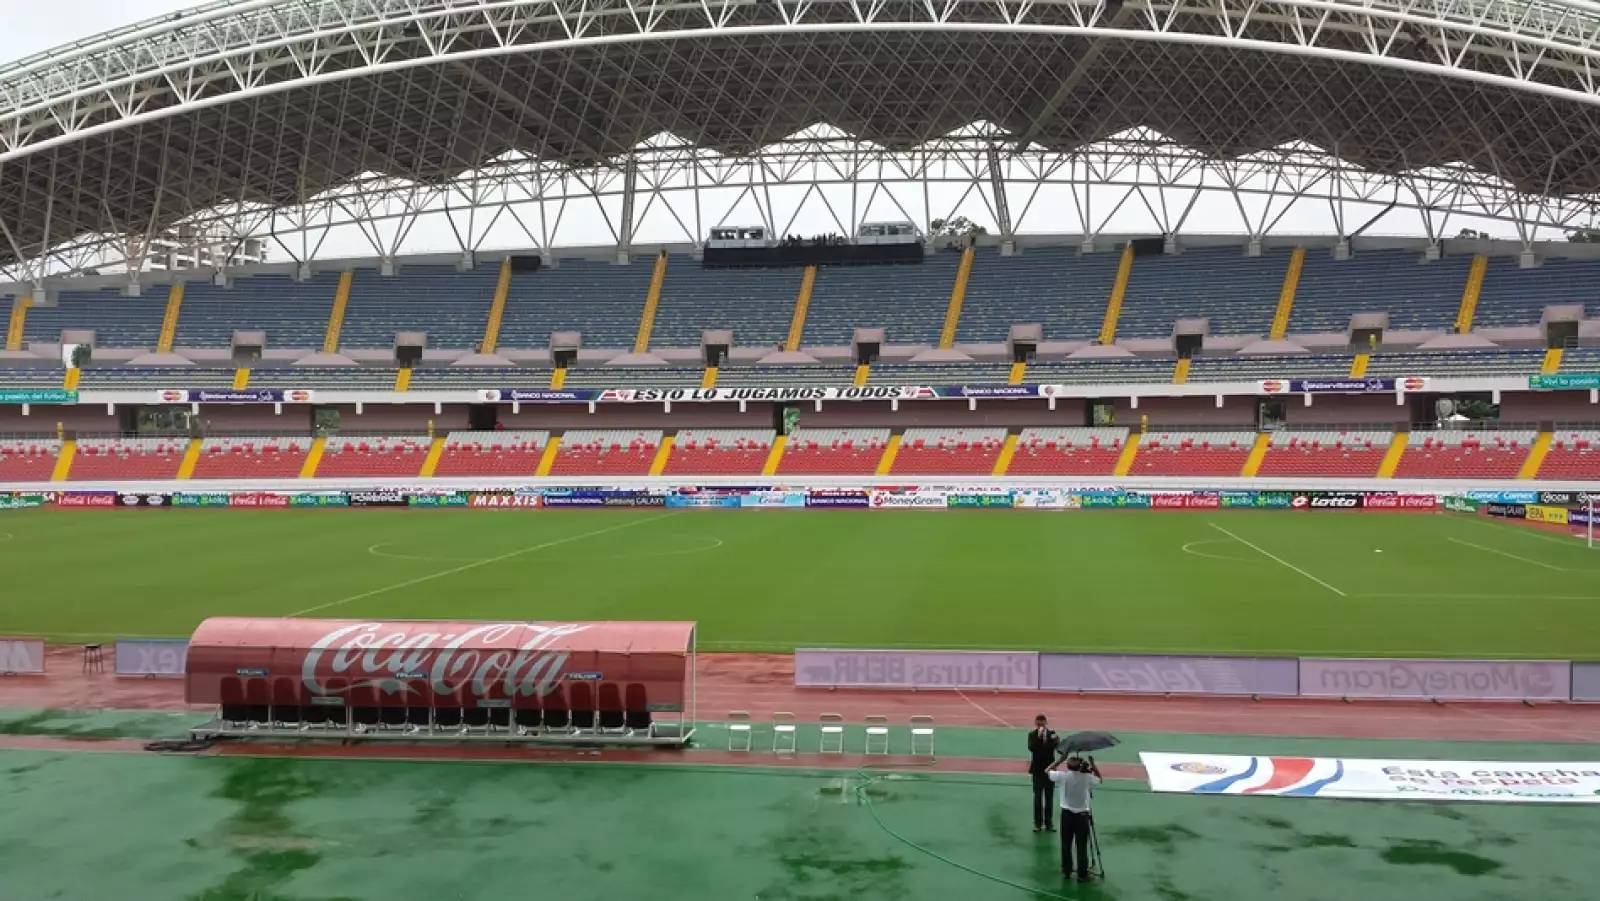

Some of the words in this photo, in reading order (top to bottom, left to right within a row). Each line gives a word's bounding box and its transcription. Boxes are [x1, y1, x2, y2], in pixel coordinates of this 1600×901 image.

[633, 389, 684, 399] ESTO
[691, 389, 717, 399] LO
[723, 387, 827, 399] JUGAMOS
[835, 386, 903, 397] TODOS
[473, 495, 537, 507] MAXXIS
[635, 497, 664, 505] GALAXY
[884, 497, 942, 507] MoneyGram
[302, 622, 594, 697] Coca-Cola
[1382, 766, 1460, 779] Esta
[1471, 769, 1600, 778] cancha
[1440, 777, 1580, 786] respeta
